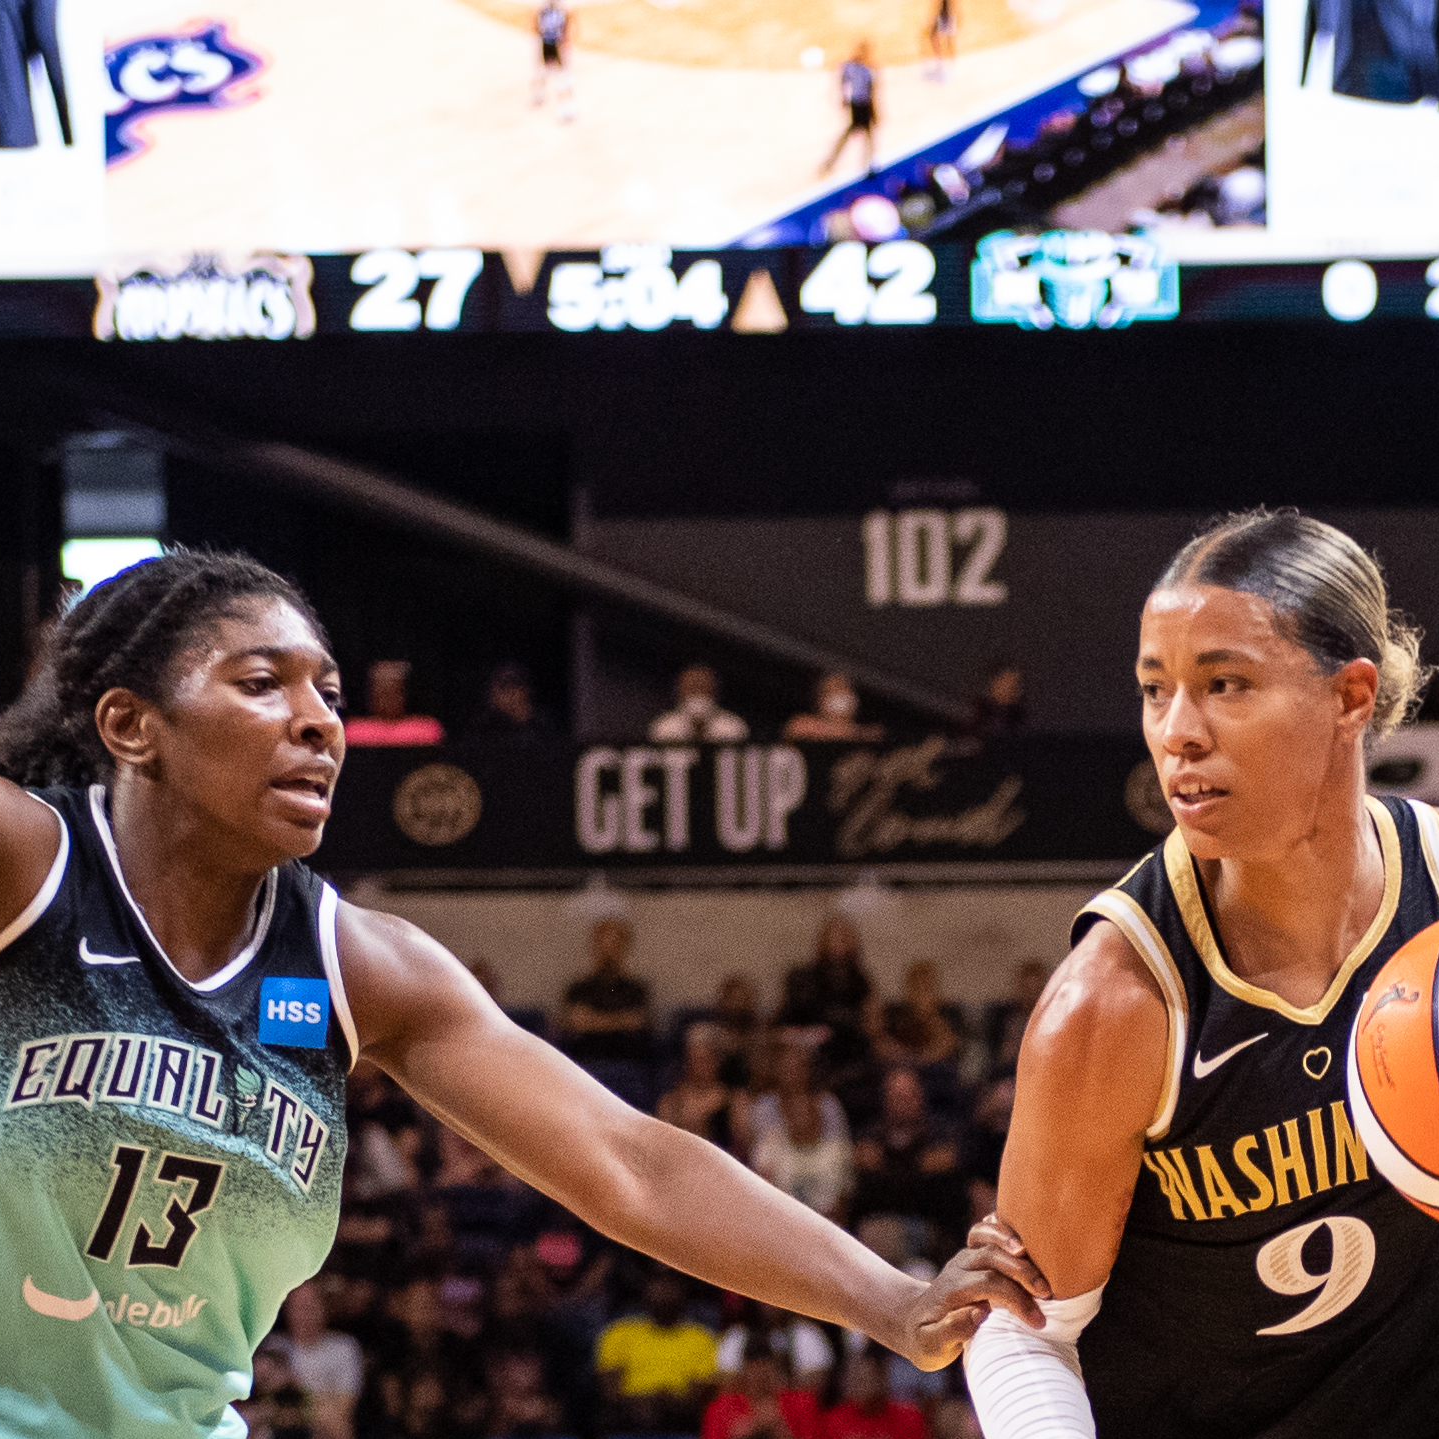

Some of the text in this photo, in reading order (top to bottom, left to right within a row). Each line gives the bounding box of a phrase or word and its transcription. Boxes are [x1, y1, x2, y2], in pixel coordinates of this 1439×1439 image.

[351, 249, 484, 332] 27
[547, 261, 729, 332] 5:04
[800, 240, 937, 325] 42
[1321, 260, 1379, 321] 0
[862, 508, 1009, 607] 102
[575, 746, 701, 853] GET
[714, 745, 809, 853] UP
[267, 999, 321, 1025] HSS
[86, 1143, 226, 1270] 13
[1144, 1100, 1368, 1222] WASHIN
[1255, 1215, 1377, 1337] 9
